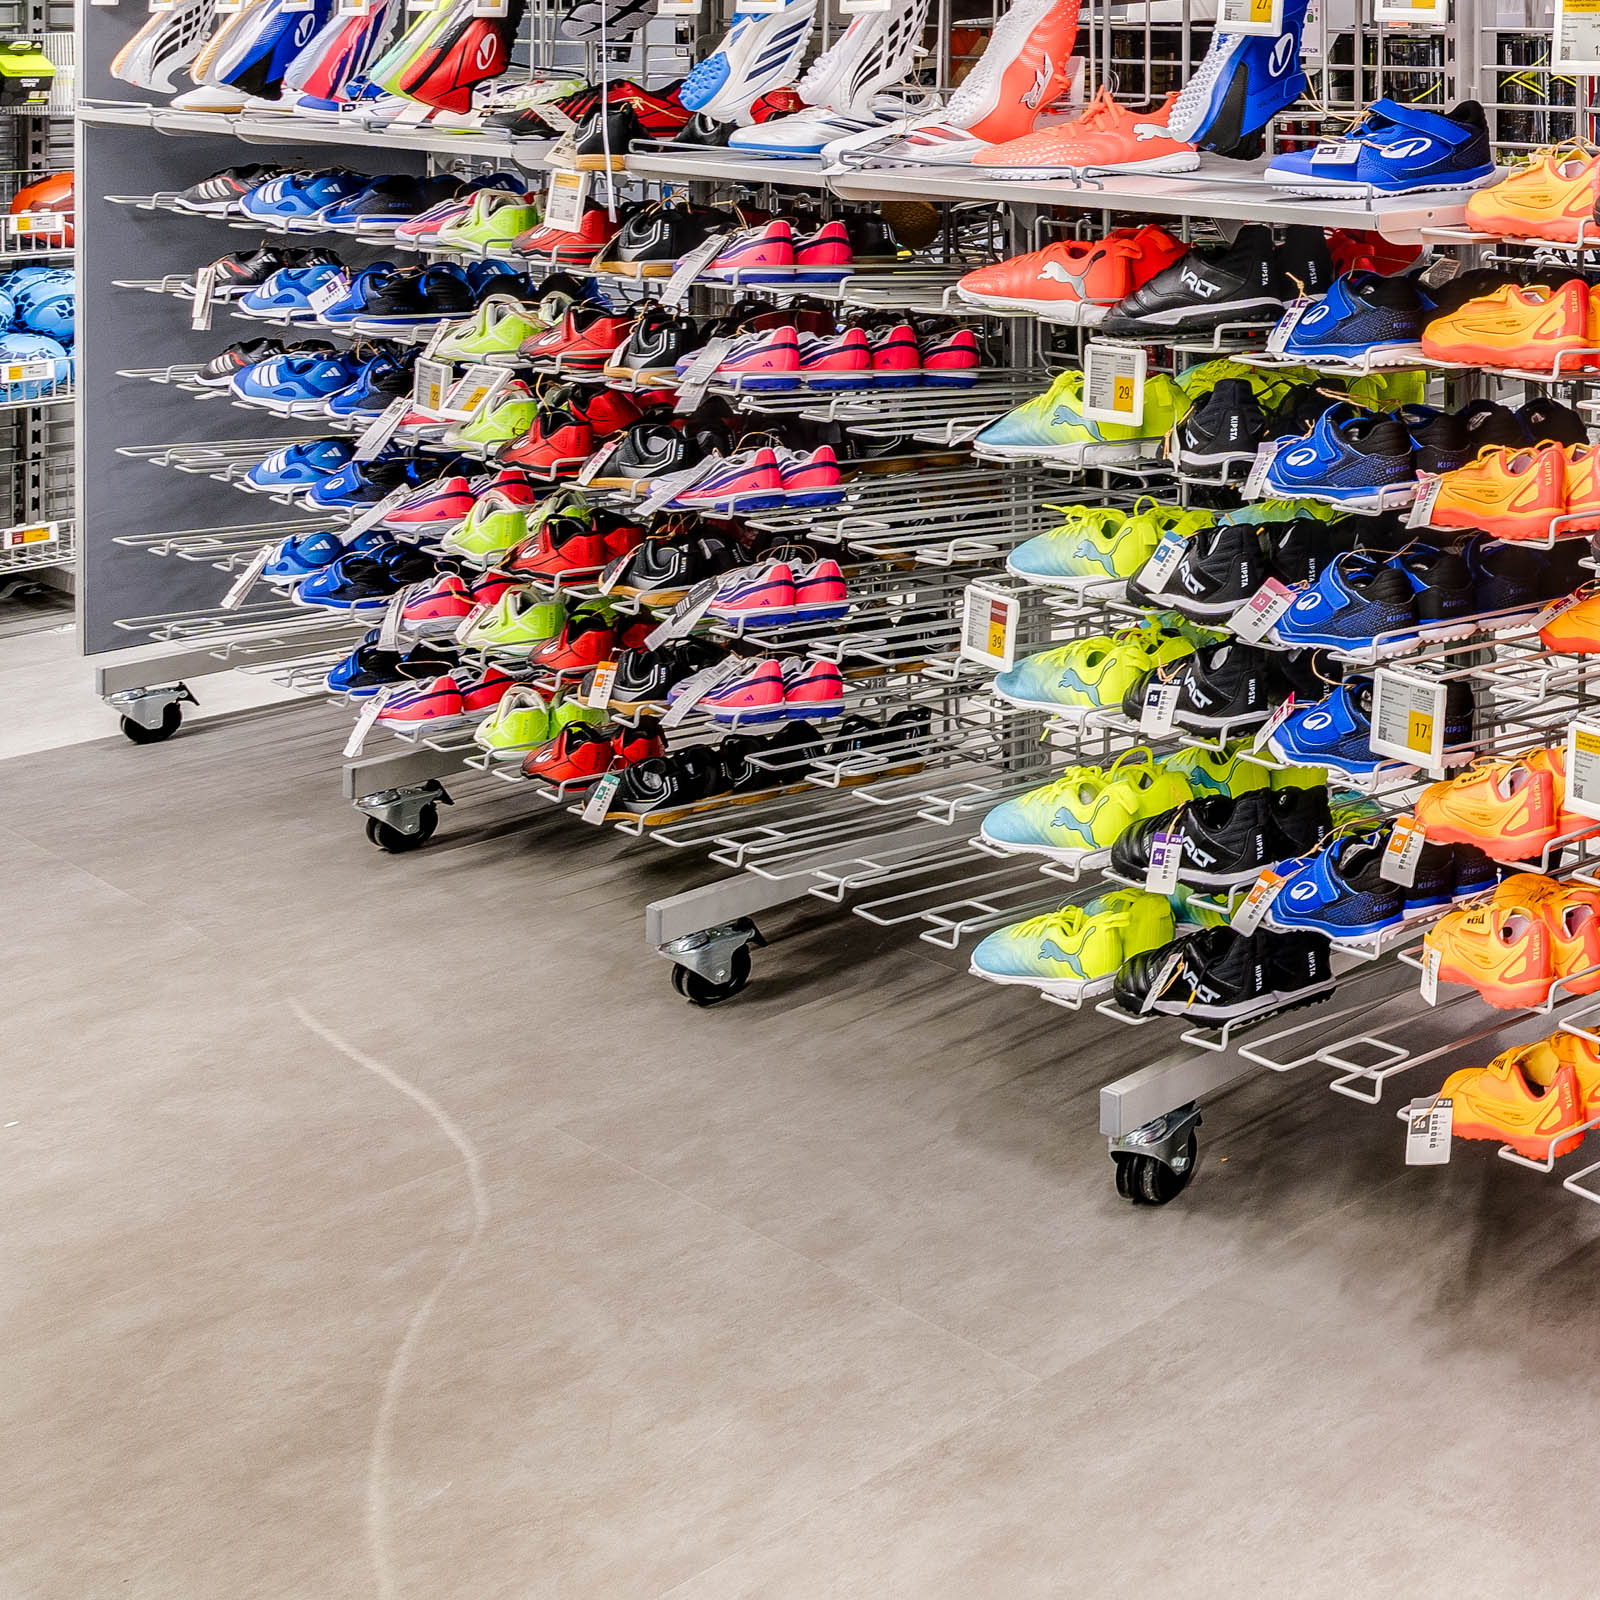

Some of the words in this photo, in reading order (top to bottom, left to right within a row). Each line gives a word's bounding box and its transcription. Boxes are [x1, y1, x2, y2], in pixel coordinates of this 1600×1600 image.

[1261, 261, 1269, 286] KIPSTA
[1307, 260, 1318, 285] KIPSTA
[1229, 415, 1239, 442] KIPSTA
[1544, 461, 1554, 487] KIPSTA
[1239, 561, 1249, 588] KIPSTA
[1247, 678, 1256, 705] KIPSTA
[1255, 833, 1264, 861] KIPSTA
[1255, 963, 1263, 992] KIPSTA
[1307, 951, 1315, 977] KIPSTA
[1562, 1081, 1572, 1110] KIPSTA
